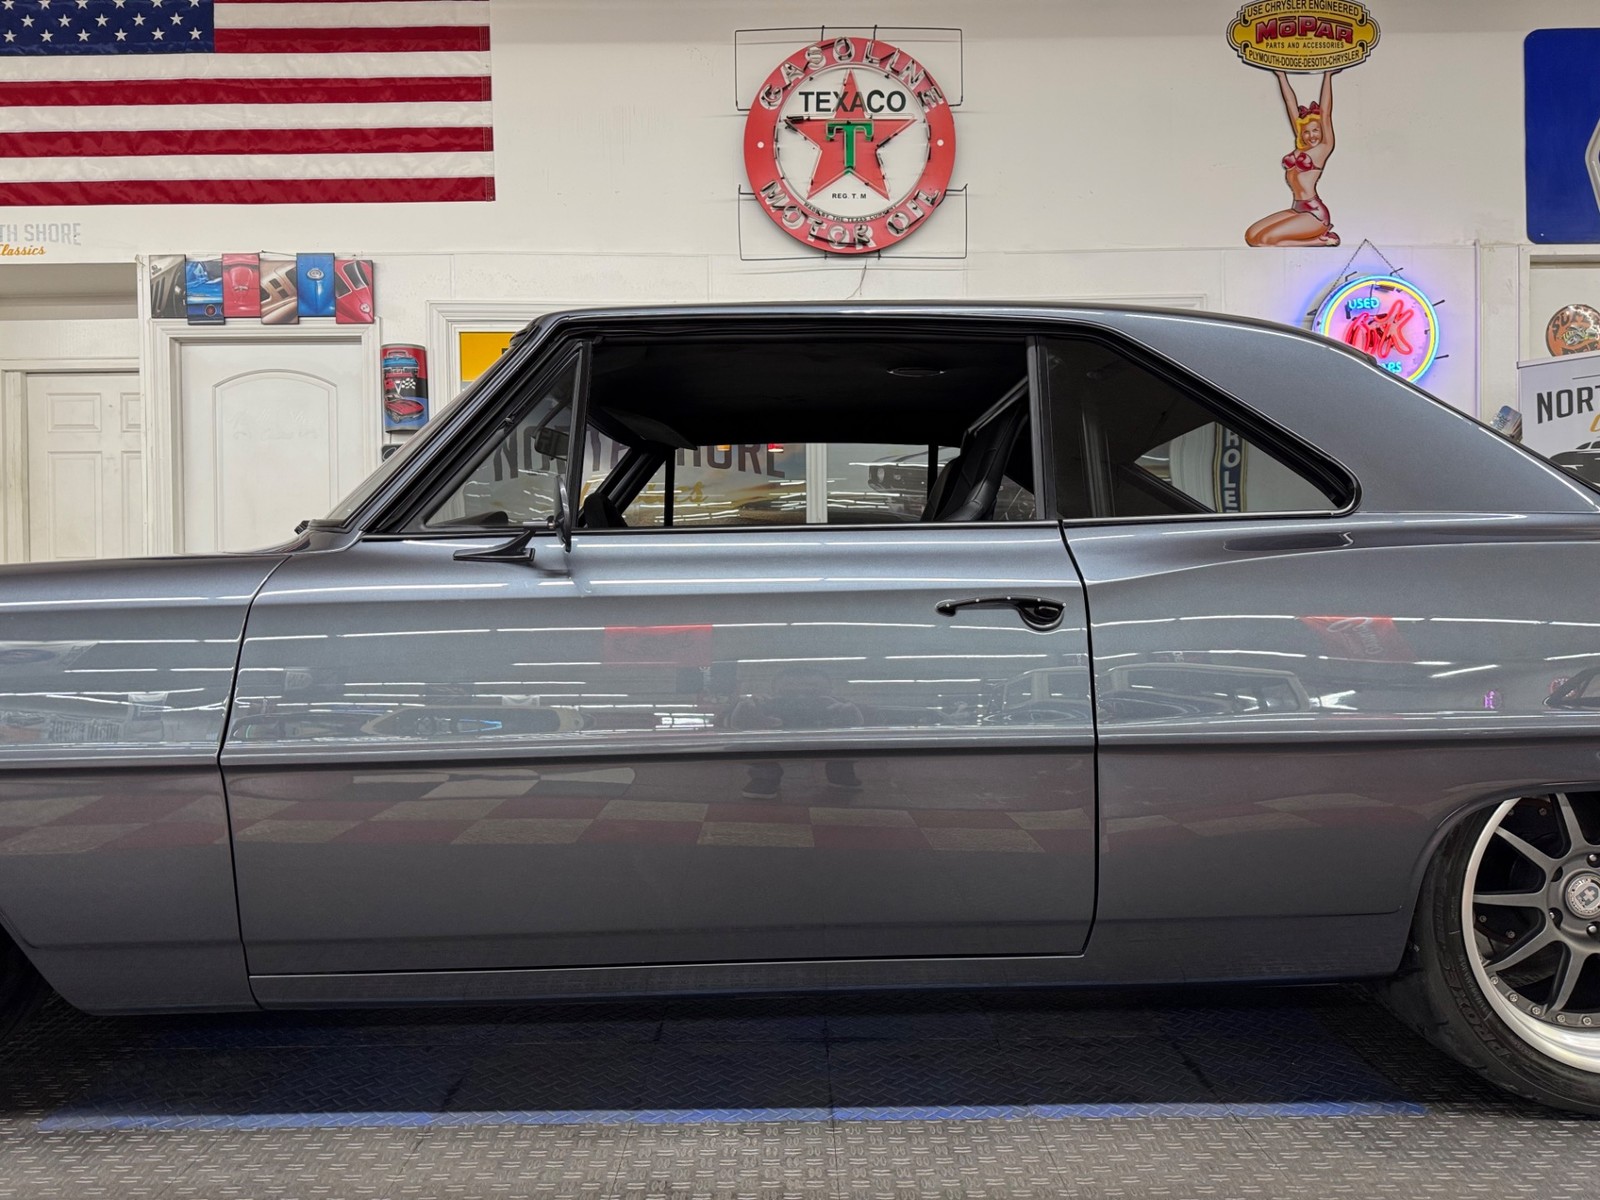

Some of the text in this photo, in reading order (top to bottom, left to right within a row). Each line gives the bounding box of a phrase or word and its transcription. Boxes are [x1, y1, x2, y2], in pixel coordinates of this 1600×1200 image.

[1247, 0, 1360, 17] USE CHRYSLER ENGINEERED
[1303, 41, 1345, 49] ACCESSORIES
[759, 37, 944, 113] GASOLINE
[798, 89, 907, 113] TEXACO
[825, 119, 875, 175] T
[760, 180, 941, 250] MOTOR OIL
[24, 222, 82, 246] SHORE
[1348, 297, 1380, 310] USED
[1537, 385, 1600, 424] NOR
